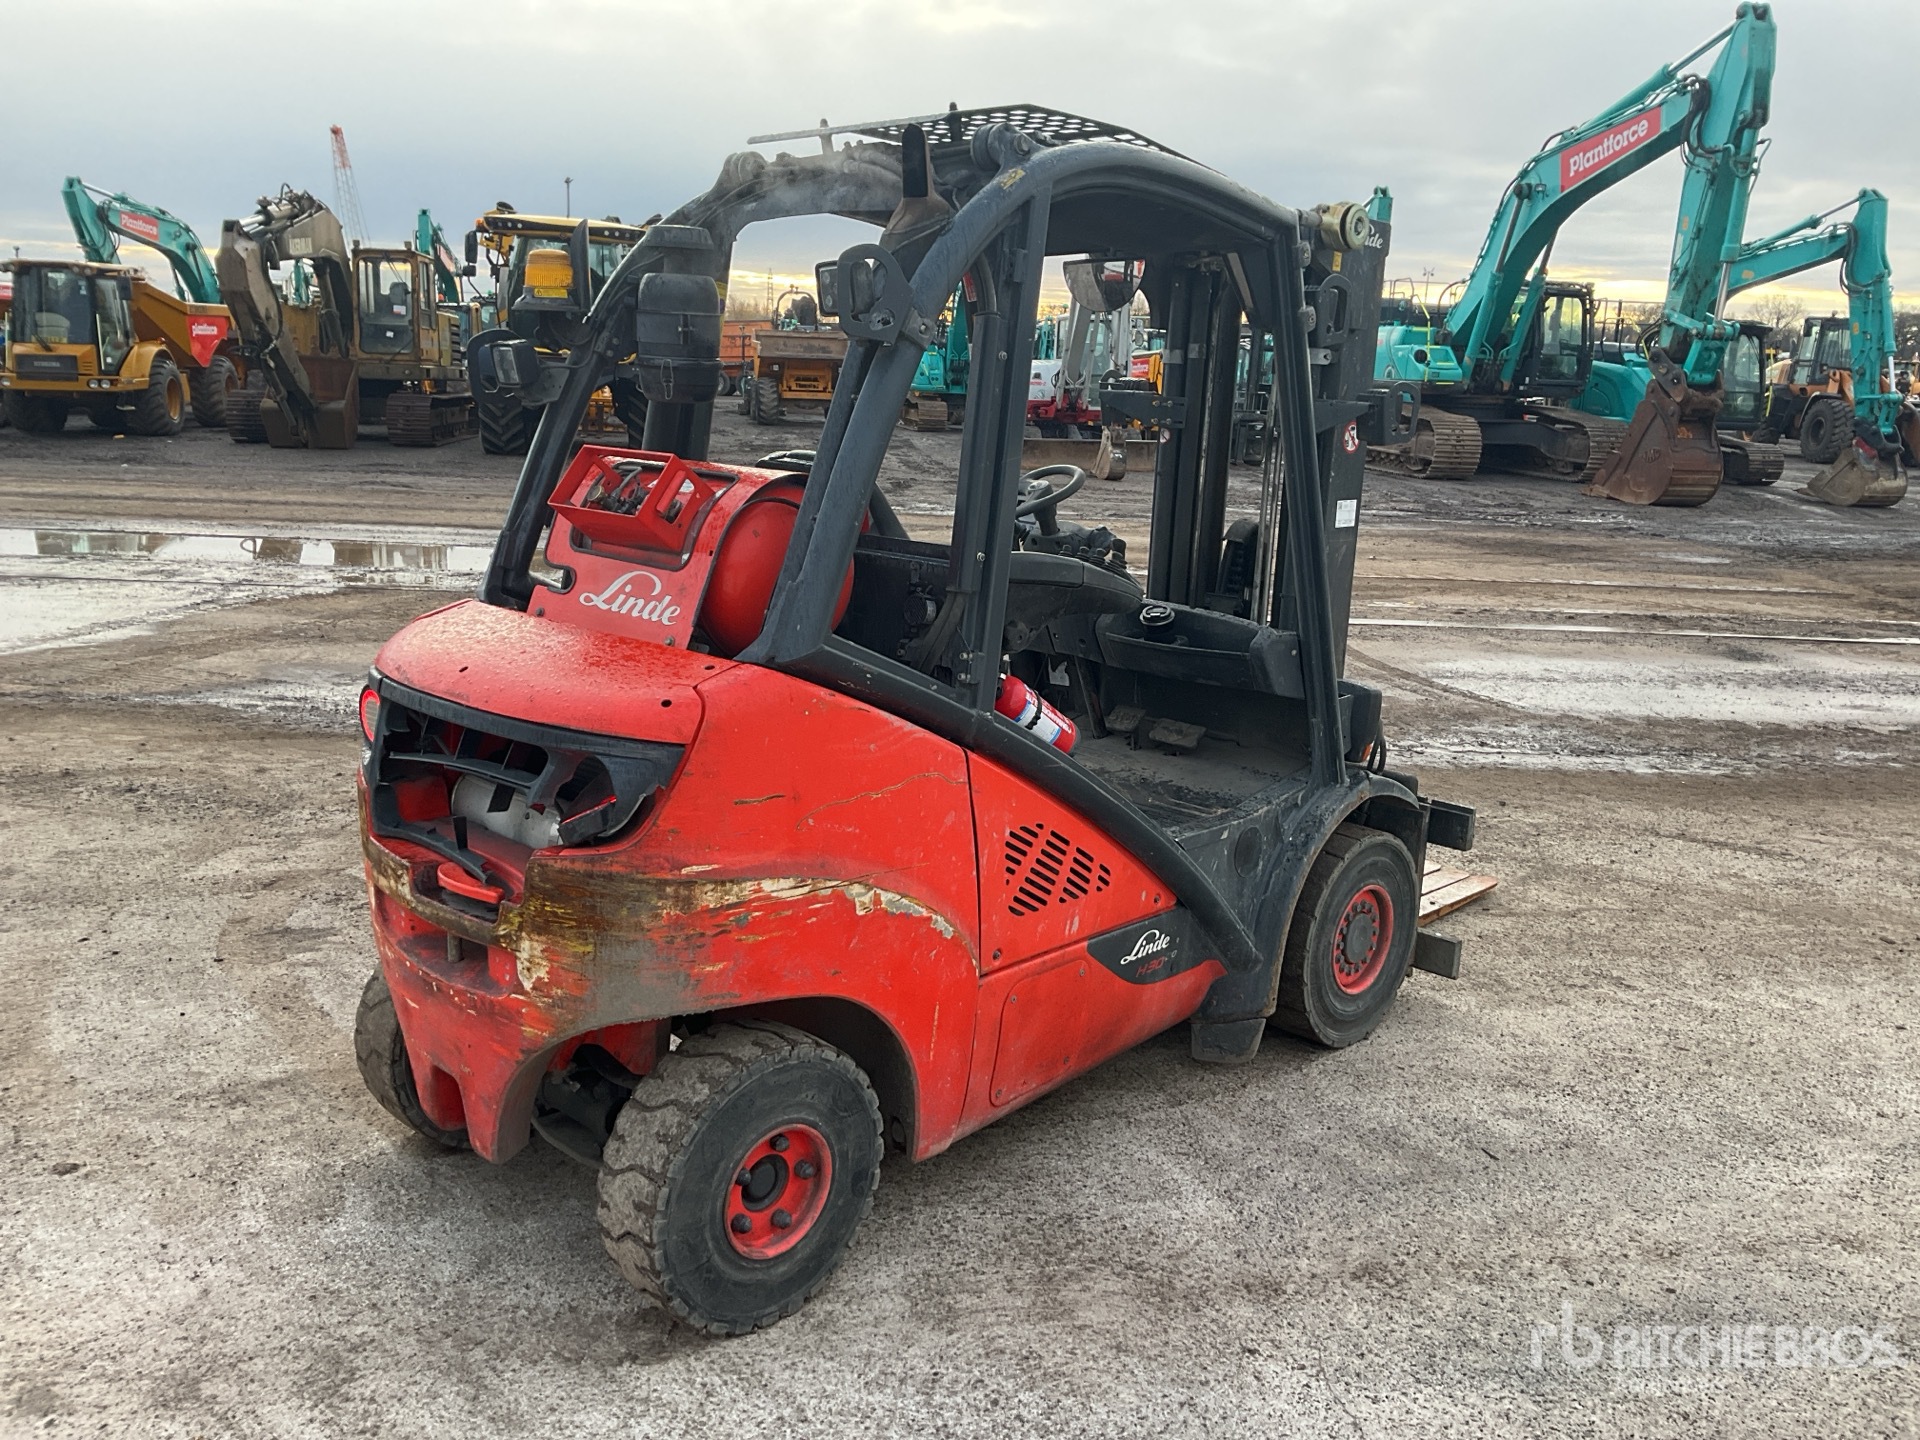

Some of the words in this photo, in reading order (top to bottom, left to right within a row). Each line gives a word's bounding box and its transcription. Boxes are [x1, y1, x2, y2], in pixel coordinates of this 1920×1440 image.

[1569, 119, 1649, 177] Plantforce
[579, 570, 681, 626] Linde
[1120, 929, 1171, 965] Linde
